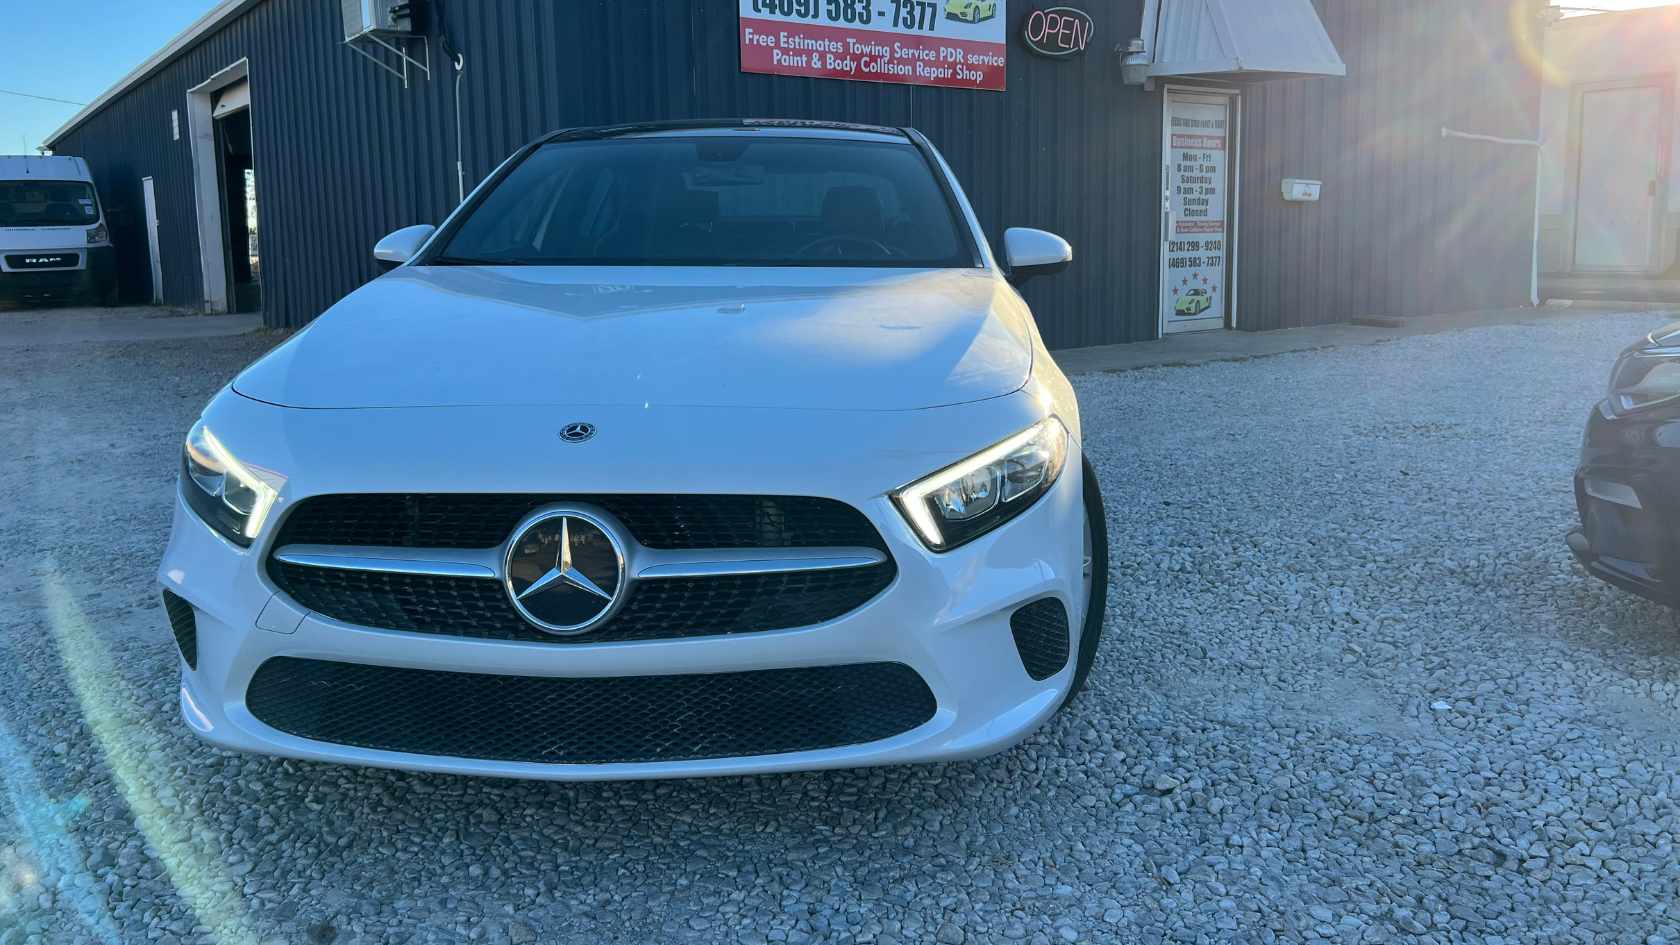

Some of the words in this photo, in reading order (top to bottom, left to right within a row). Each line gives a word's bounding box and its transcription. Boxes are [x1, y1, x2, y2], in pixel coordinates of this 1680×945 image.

[826, 0, 872, 25] 583
[890, 0, 937, 31] 7377
[1028, 11, 1089, 50] OPEN
[745, 28, 775, 46] Free
[780, 31, 843, 53] Estimates
[847, 38, 890, 60] Towing
[894, 42, 936, 60] Service
[940, 47, 964, 63] PDR
[967, 52, 1004, 66] service
[773, 49, 807, 67] Paint
[811, 52, 822, 69] &
[826, 54, 857, 75] Body
[861, 57, 912, 75] Collision
[916, 62, 952, 80] Repair
[956, 65, 983, 84] Shop
[1181, 174, 1212, 185] Saturday
[1183, 165, 1194, 173] am
[1183, 187, 1193, 195] am
[1183, 196, 1209, 207] Sunday
